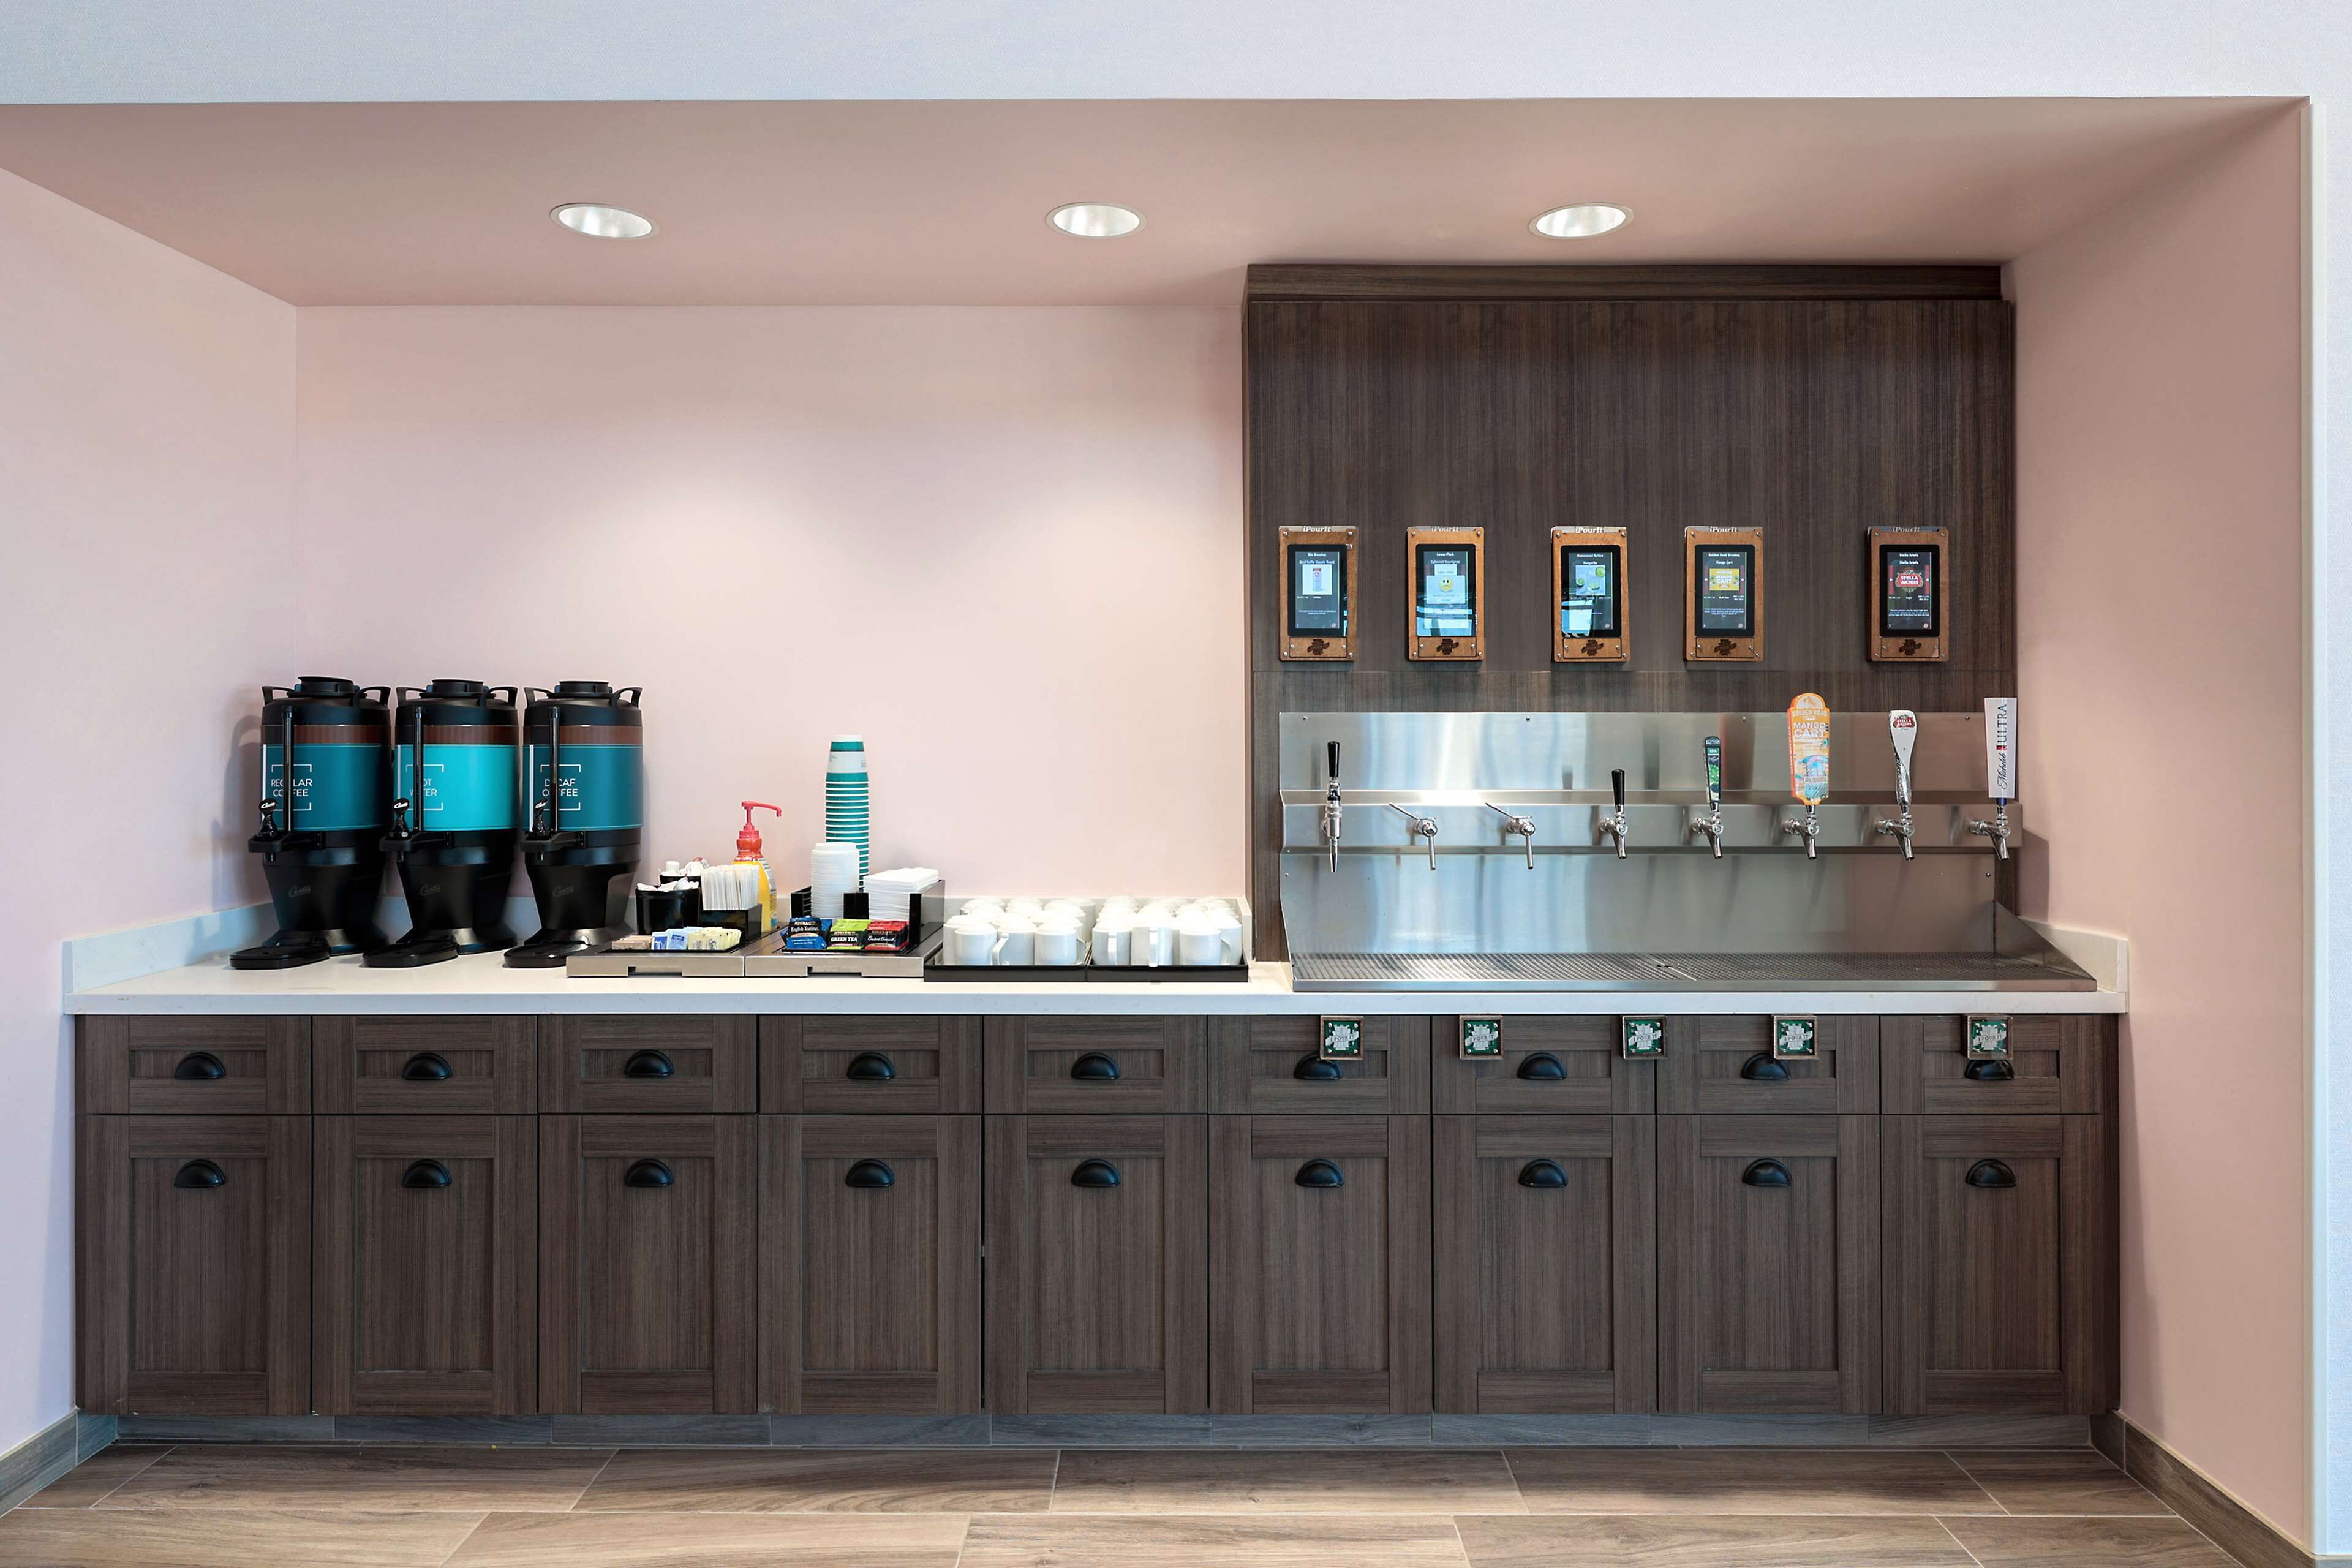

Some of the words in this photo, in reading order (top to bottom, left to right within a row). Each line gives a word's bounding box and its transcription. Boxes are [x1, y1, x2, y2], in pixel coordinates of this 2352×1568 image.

[1794, 729, 1824, 737] CART
[1997, 704, 2007, 743] ULTRA
[545, 778, 576, 787] DCAF
[1997, 752, 2008, 790] Michelob
